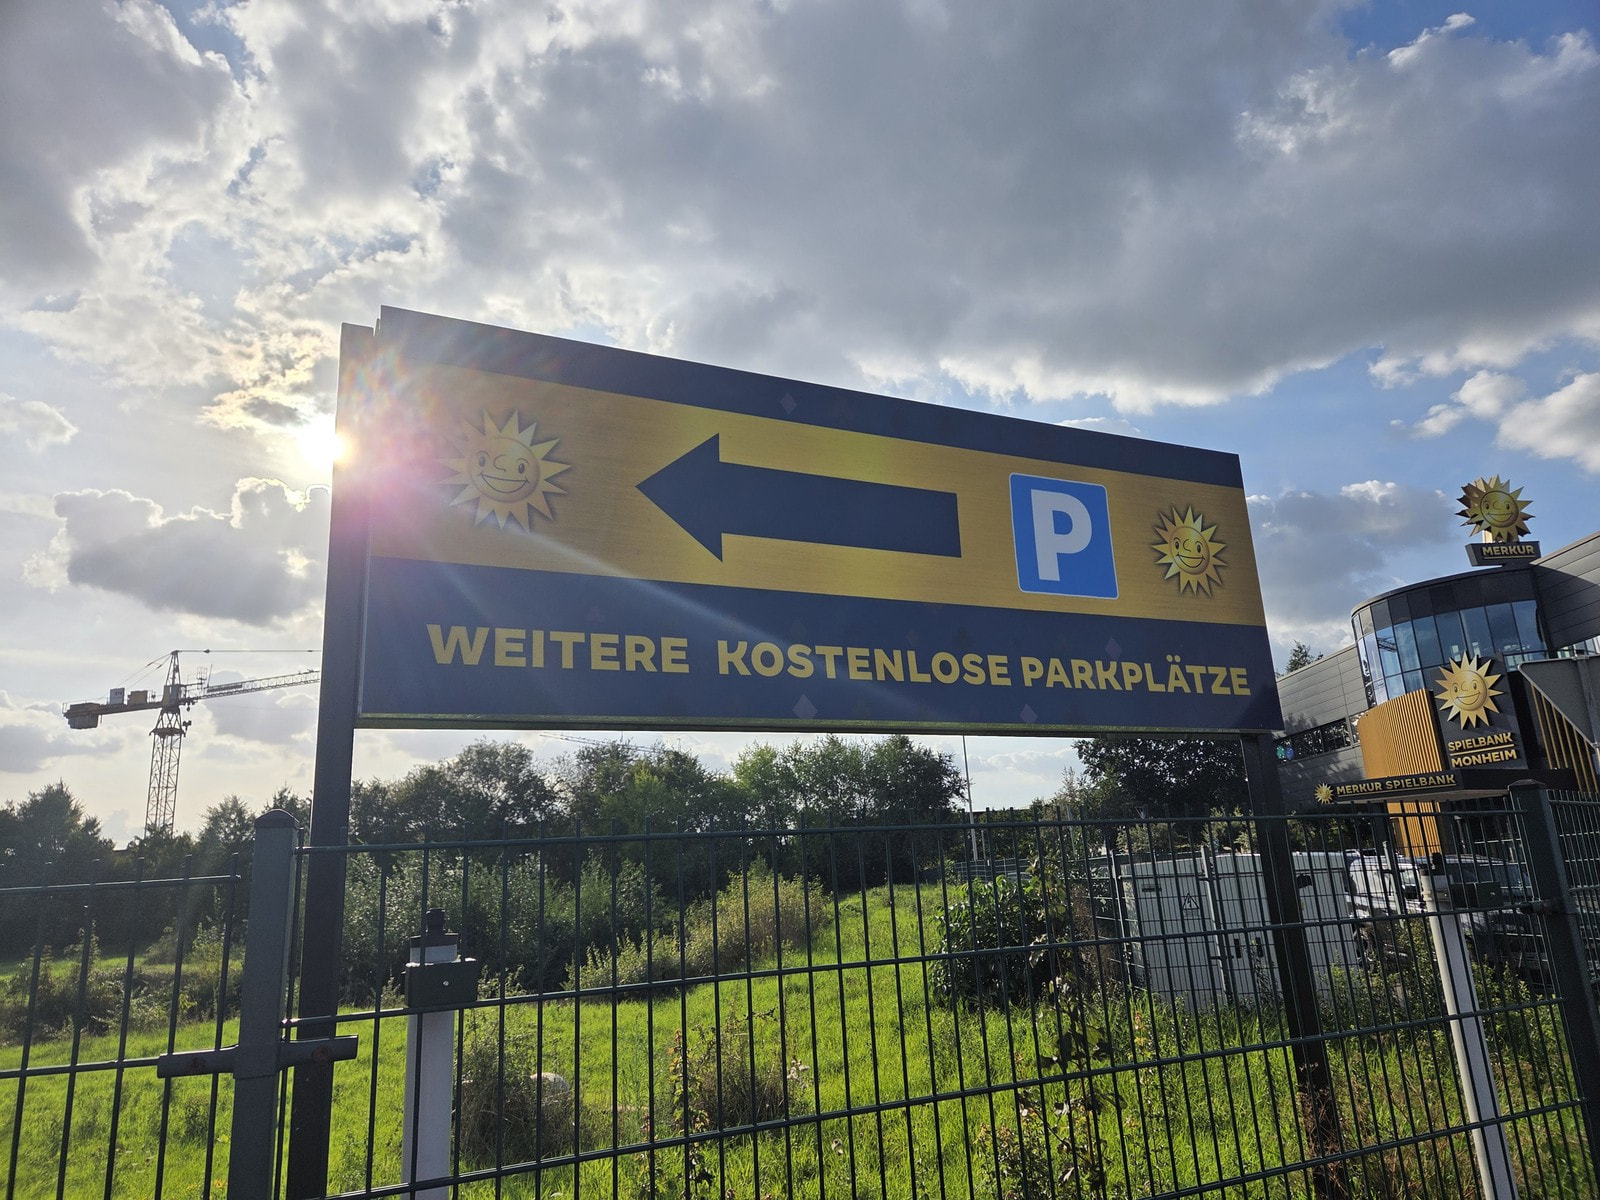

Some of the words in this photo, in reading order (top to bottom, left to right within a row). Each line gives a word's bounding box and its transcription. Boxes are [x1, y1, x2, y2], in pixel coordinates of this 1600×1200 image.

[1031, 489, 1092, 581] P
[1482, 544, 1535, 556] MERKUR
[427, 624, 690, 674] WEITERE
[717, 639, 1012, 687] KOSTENLOSE
[1022, 654, 1252, 696] PARKPLÄTZE
[1448, 732, 1513, 752] SPIELBANK
[1451, 749, 1517, 768] MONHEIM
[1336, 782, 1383, 795] MERKUR
[1386, 774, 1456, 790] SPIELBANK
